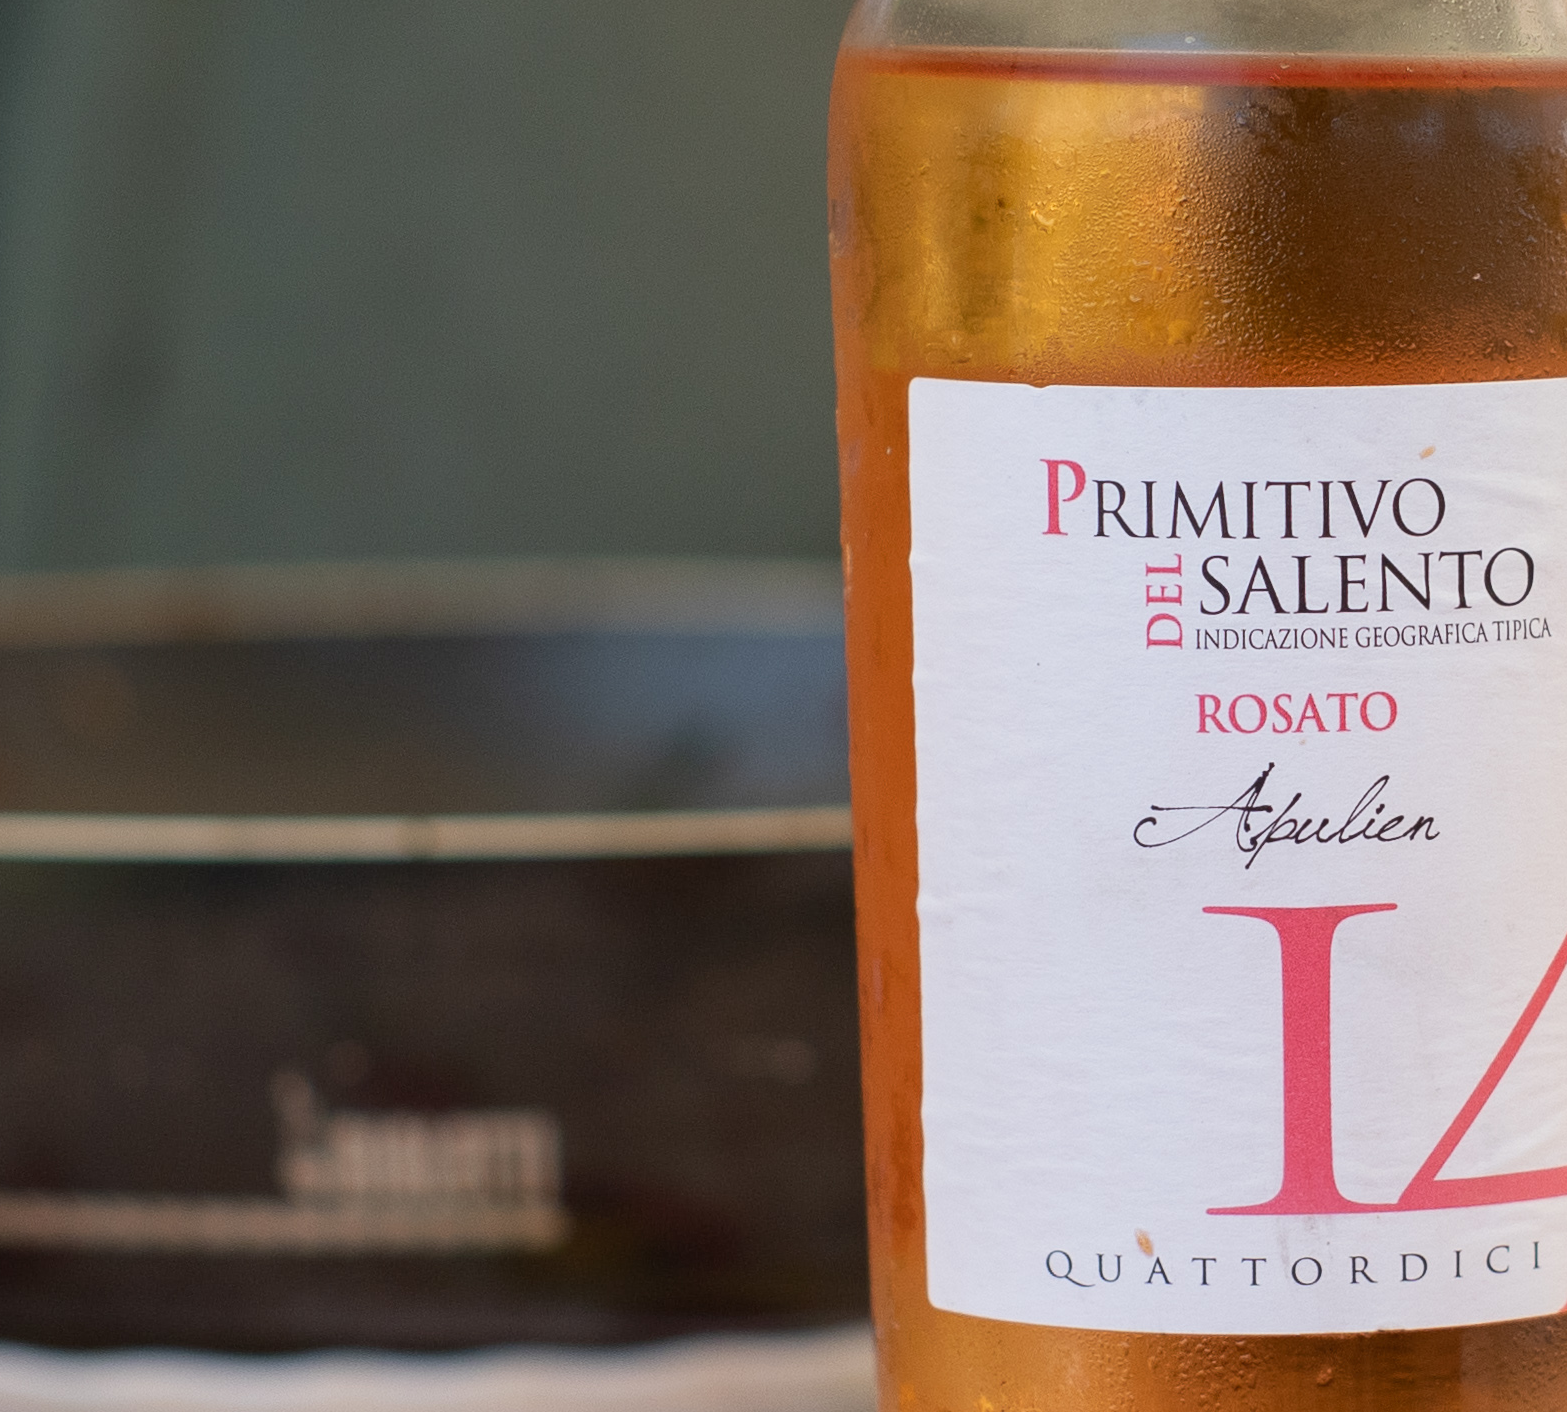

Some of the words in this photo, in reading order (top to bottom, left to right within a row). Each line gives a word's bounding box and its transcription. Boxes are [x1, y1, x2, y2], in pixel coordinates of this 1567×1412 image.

[1039, 457, 1447, 541] PRIMITIVO
[1145, 552, 1184, 651] DEL
[1198, 546, 1536, 617] SALENTO
[1194, 626, 1350, 651] INDICAZIONE
[1354, 621, 1489, 650] GEOGRAFICA
[1492, 617, 1553, 643] TIPICA
[1195, 690, 1399, 735] ROSATO
[1133, 761, 1441, 871] Apulien
[1044, 1239, 1542, 1289] QUATTORDICI
